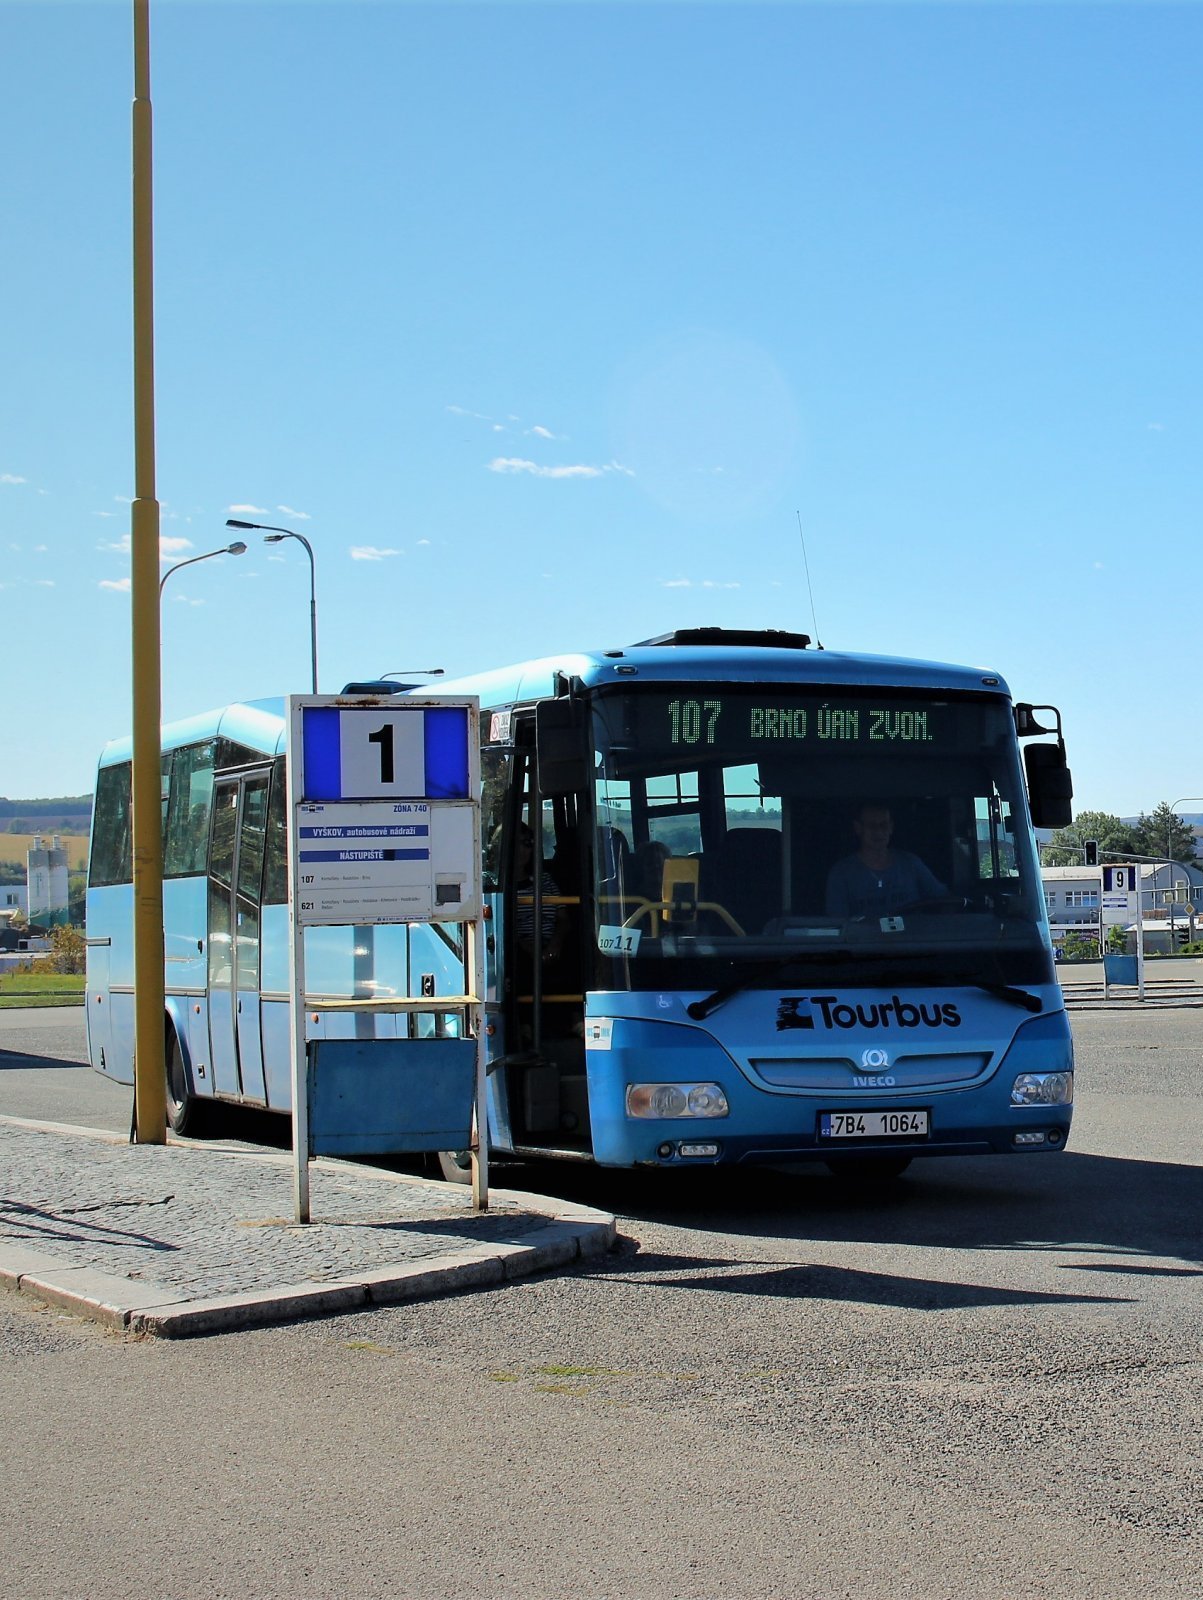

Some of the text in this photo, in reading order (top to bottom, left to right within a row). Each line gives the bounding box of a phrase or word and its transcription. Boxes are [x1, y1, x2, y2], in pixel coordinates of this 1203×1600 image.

[668, 700, 933, 743] 107 BRNO ÚAN ZVON.
[368, 724, 394, 783] 1
[393, 804, 427, 813] ZÓNA 740
[312, 826, 416, 837] VYŠKOV, autobusové nádraží
[301, 875, 315, 884] 107
[1116, 871, 1124, 888] 9
[301, 902, 315, 910] 621
[600, 935, 633, 952] 107 11
[809, 995, 962, 1029] Tourbus
[852, 1076, 896, 1087] IVECO
[835, 1115, 866, 1135] 7B4
[880, 1113, 920, 1134] 1064
